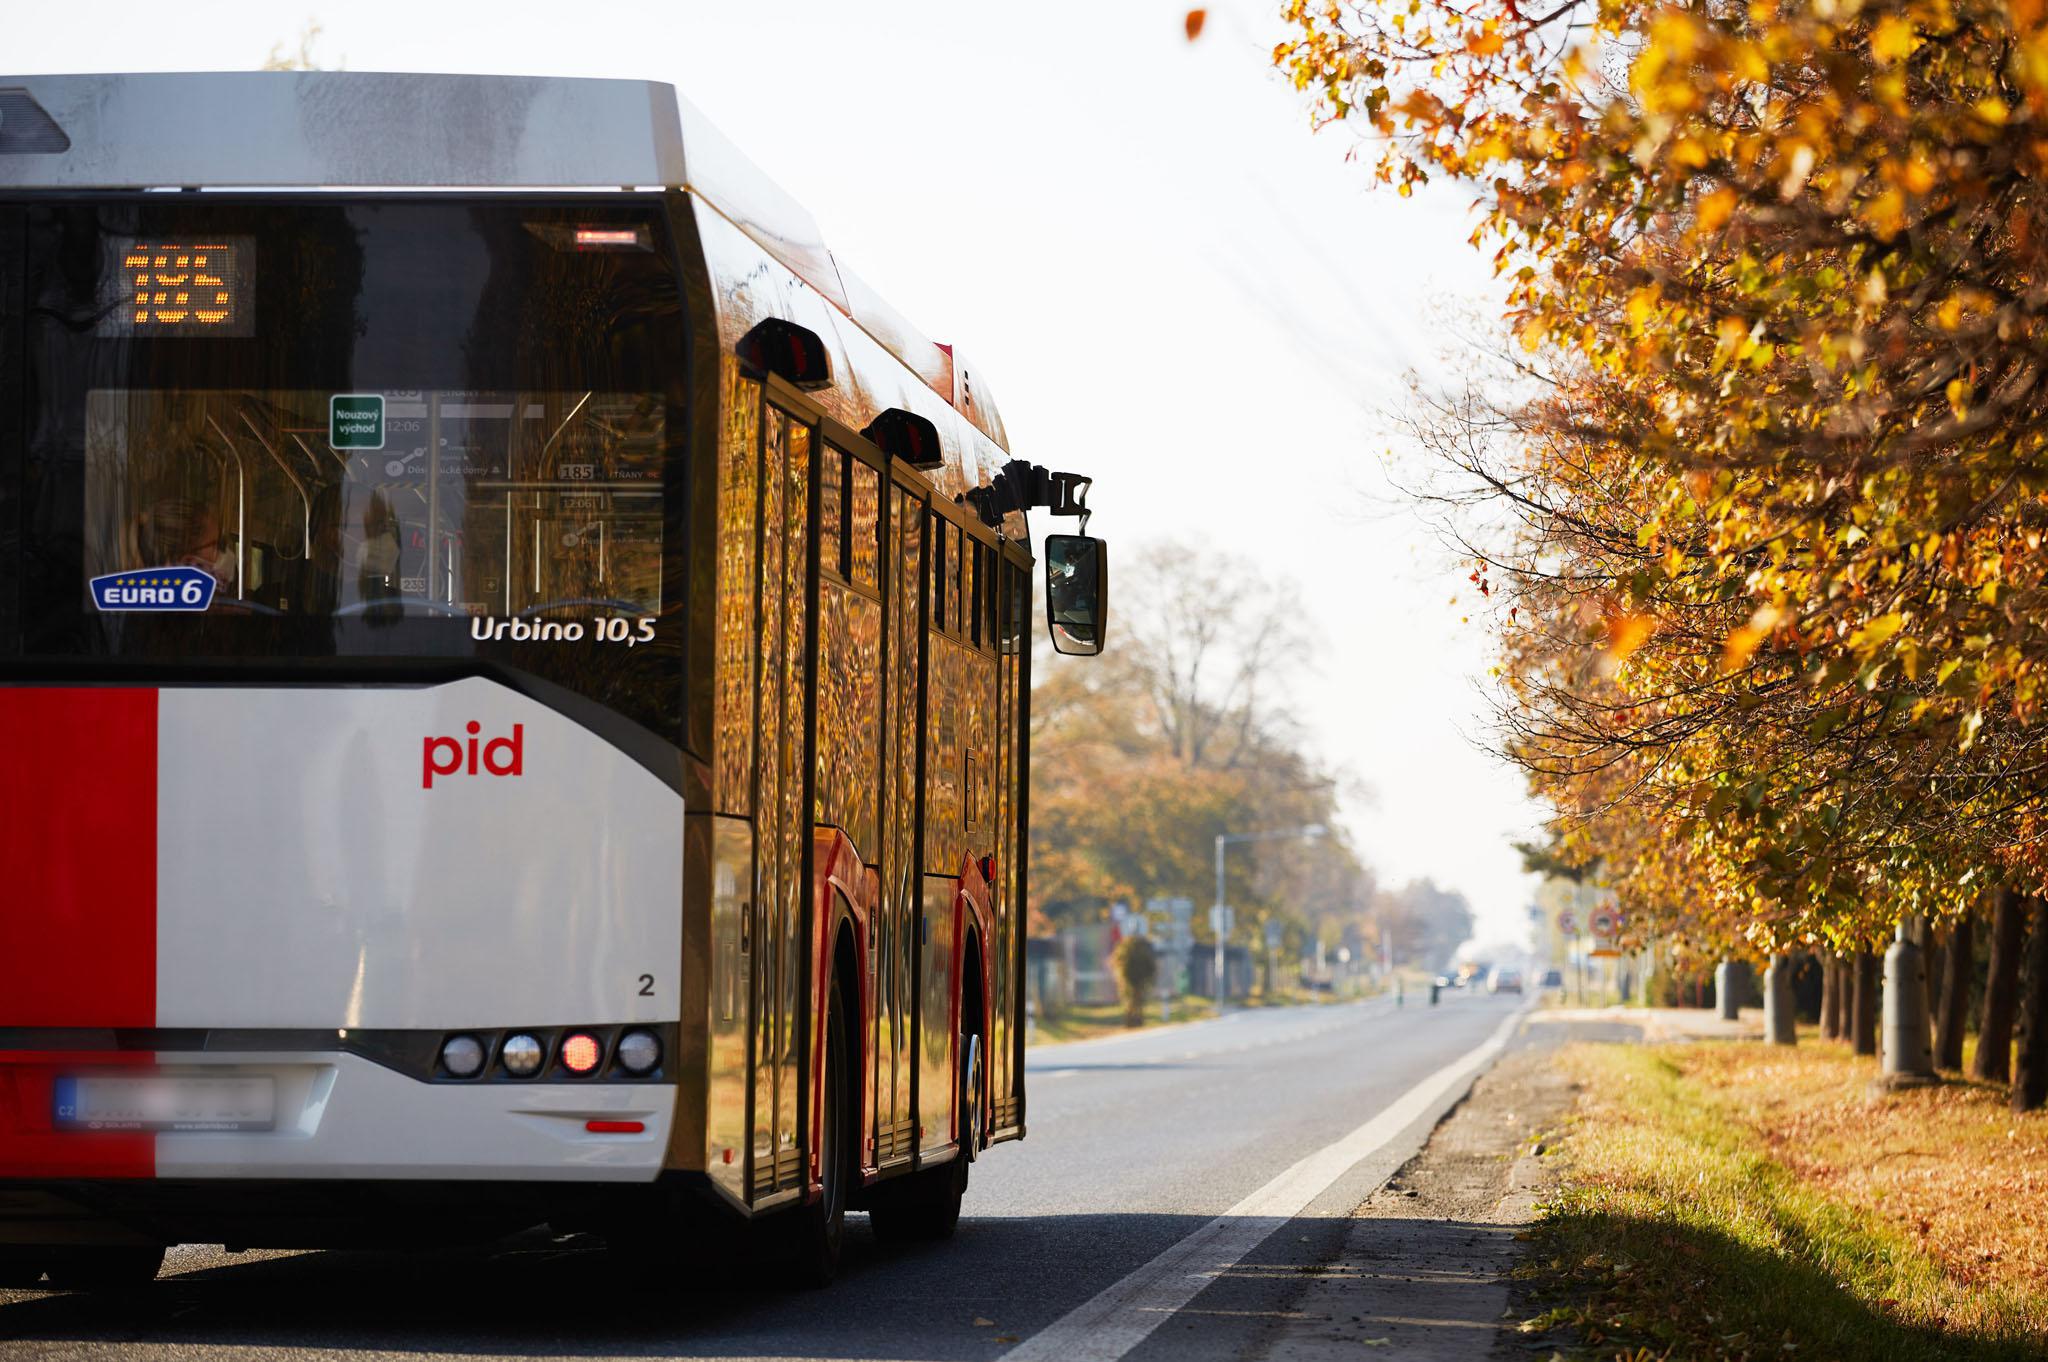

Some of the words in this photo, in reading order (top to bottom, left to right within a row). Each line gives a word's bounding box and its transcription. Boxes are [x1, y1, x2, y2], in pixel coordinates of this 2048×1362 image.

[124, 243, 230, 324] 185
[336, 408, 379, 422] Nouzový
[339, 423, 376, 436] východ
[563, 466, 592, 479] 185
[103, 587, 175, 604] EURO
[181, 579, 203, 604] 6
[470, 616, 585, 642] Urbino
[593, 617, 657, 648] 10,5
[422, 720, 524, 790] pid
[638, 973, 655, 997] 2
[58, 1105, 75, 1116] CZ
